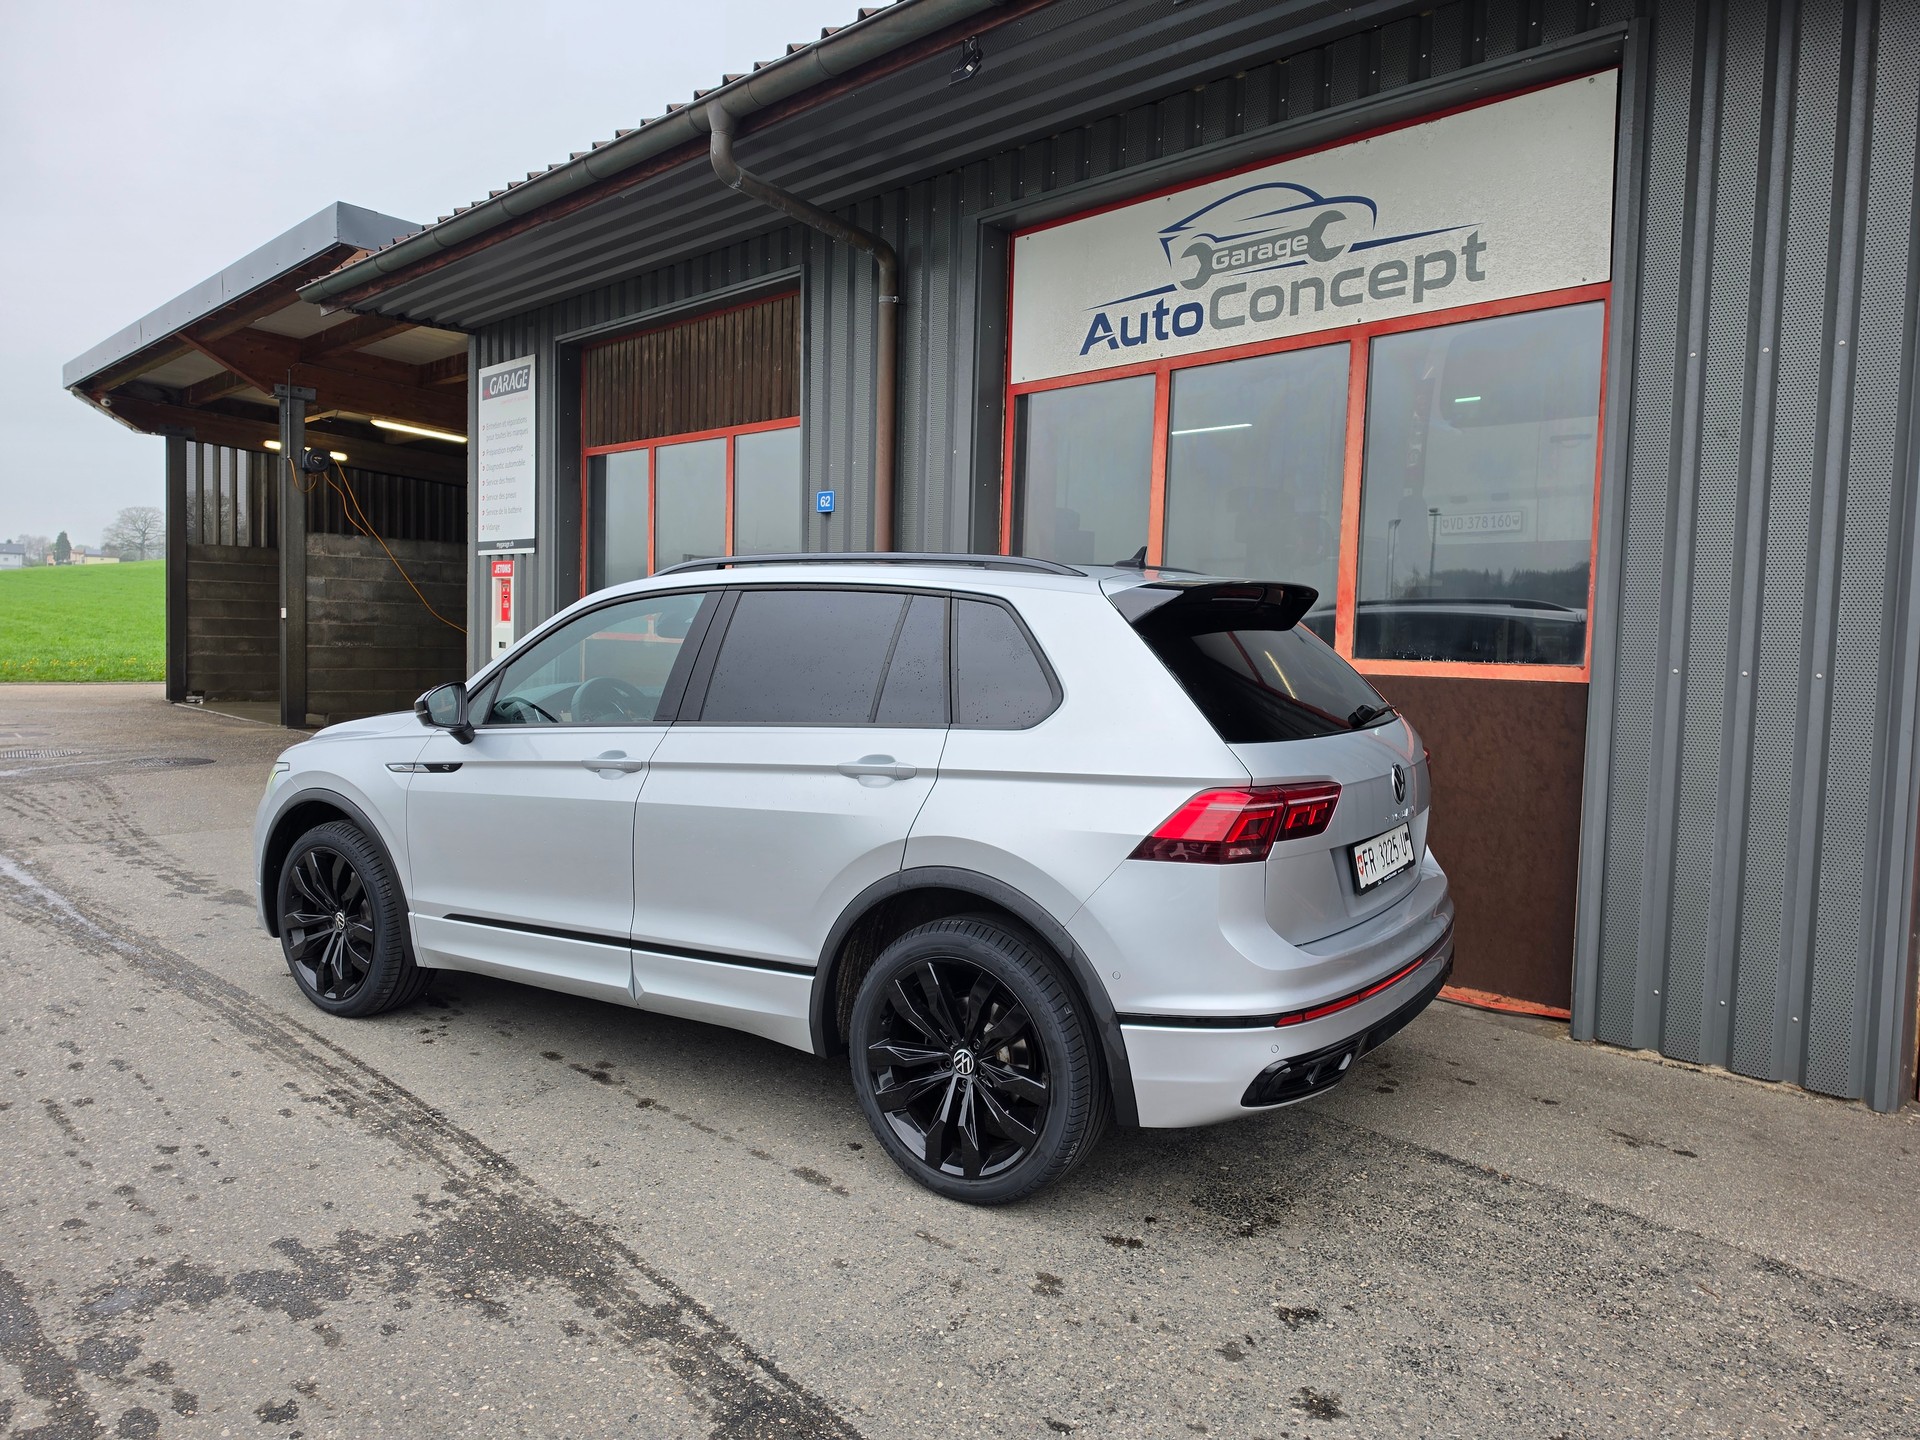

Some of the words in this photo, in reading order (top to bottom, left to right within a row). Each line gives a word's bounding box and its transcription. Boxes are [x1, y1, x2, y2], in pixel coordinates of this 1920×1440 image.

[1210, 231, 1309, 271] Garage
[490, 369, 528, 395] GARAGE
[486, 478, 498, 487] Service
[486, 493, 498, 502] Service
[820, 496, 830, 507] 62
[486, 508, 498, 517] Service
[1450, 517, 1464, 530] VD
[495, 564, 511, 573] JETONS
[1362, 847, 1377, 878] FR
[1379, 834, 1400, 870] 3225
